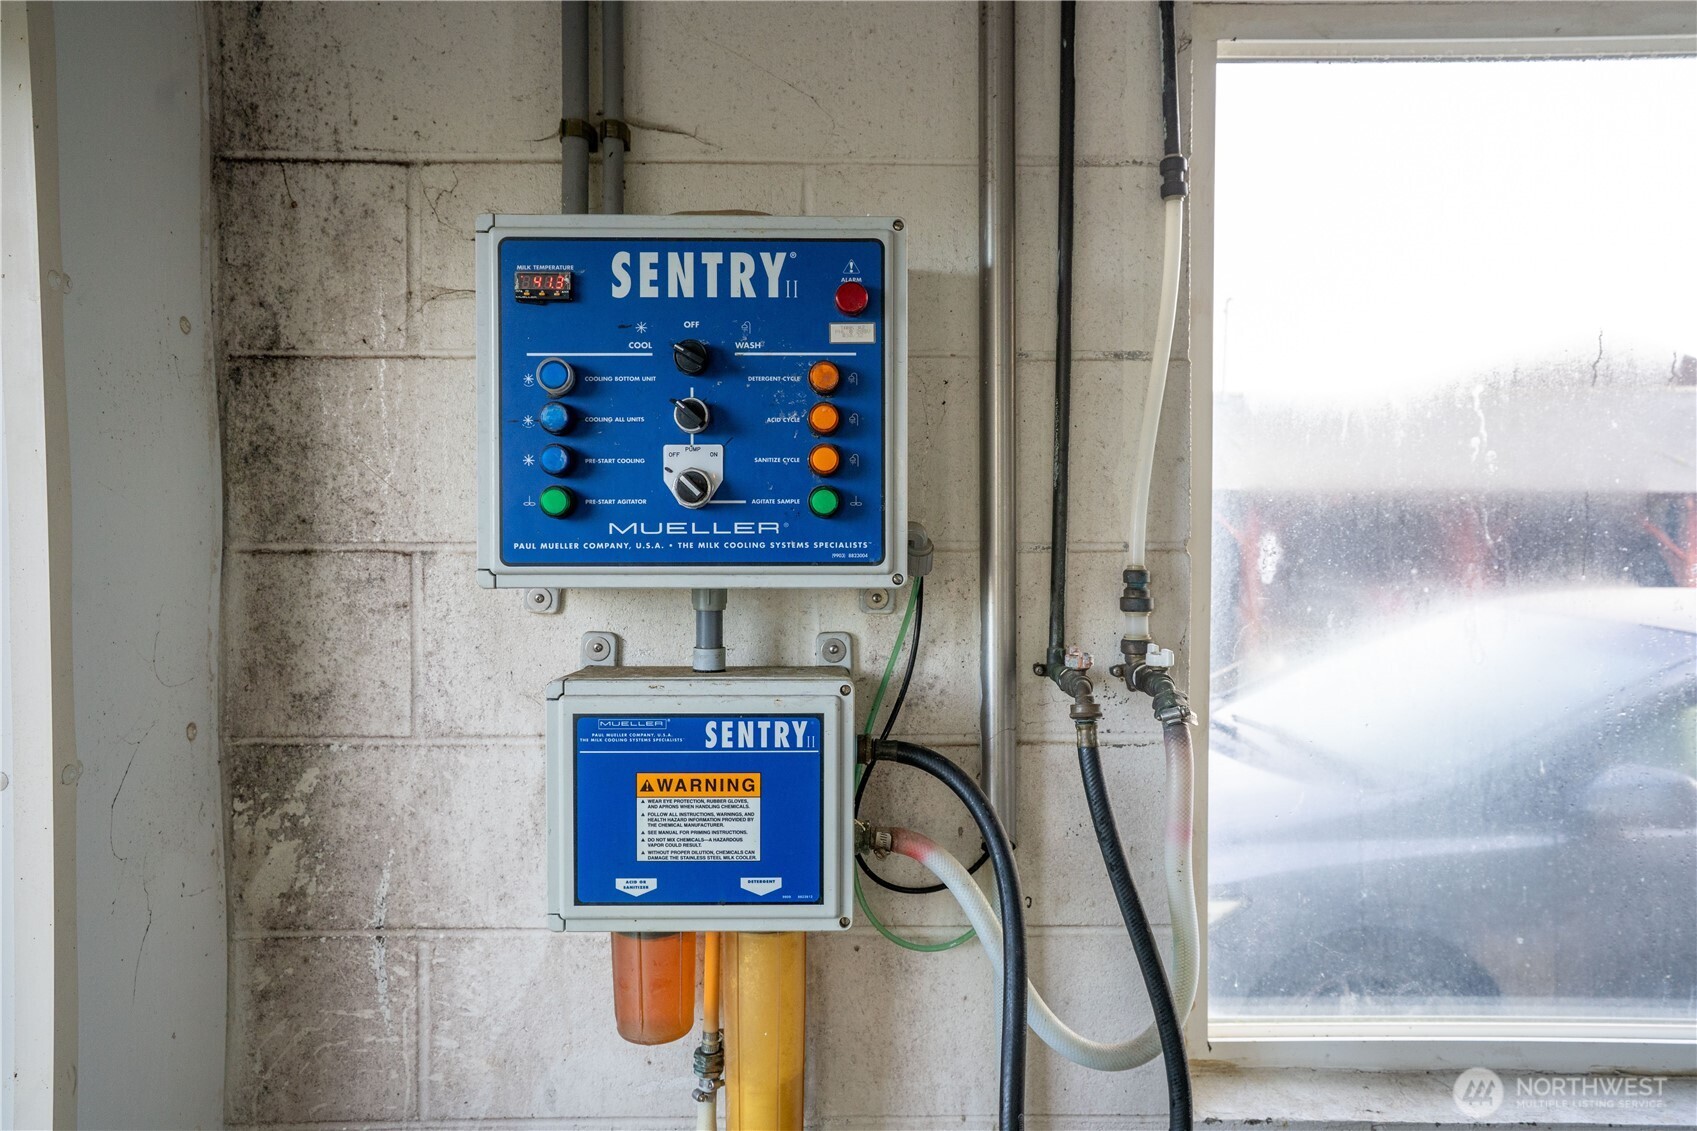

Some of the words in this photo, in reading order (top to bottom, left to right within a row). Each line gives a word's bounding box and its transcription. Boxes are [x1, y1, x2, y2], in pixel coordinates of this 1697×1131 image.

[533, 275, 564, 289] 41.3
[705, 721, 808, 748] SENTRY
[656, 778, 755, 792] WARNING
